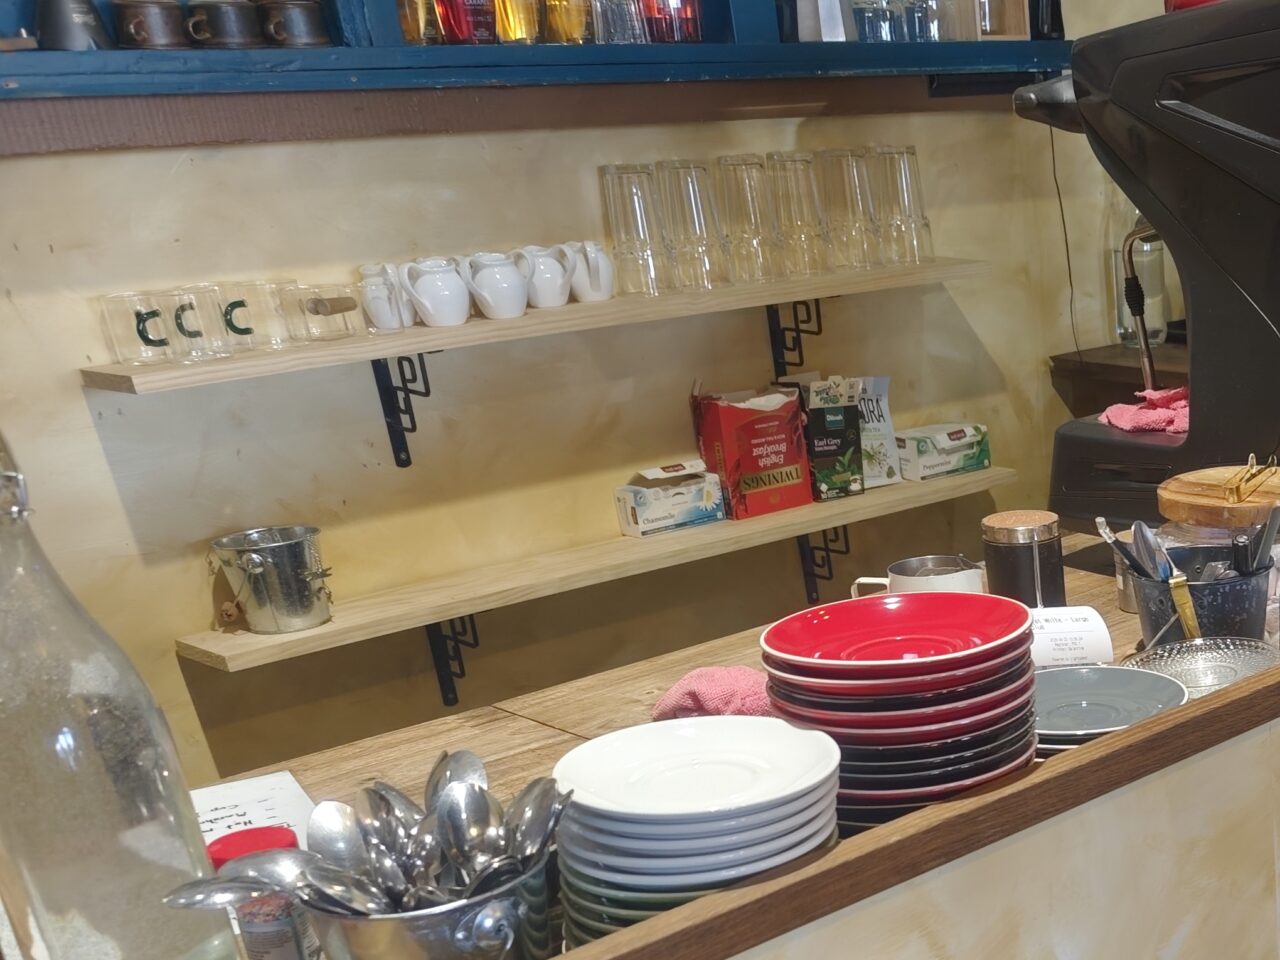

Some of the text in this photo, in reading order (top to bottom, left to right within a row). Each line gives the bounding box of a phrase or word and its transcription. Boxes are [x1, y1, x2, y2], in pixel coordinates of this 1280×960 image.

[814, 438, 841, 447] Earl Grey
[752, 442, 786, 457] Breakfast
[758, 454, 784, 468] English
[922, 460, 952, 471] Peppermint
[743, 466, 801, 489] TWININGS
[643, 513, 675, 525] Chamomile
